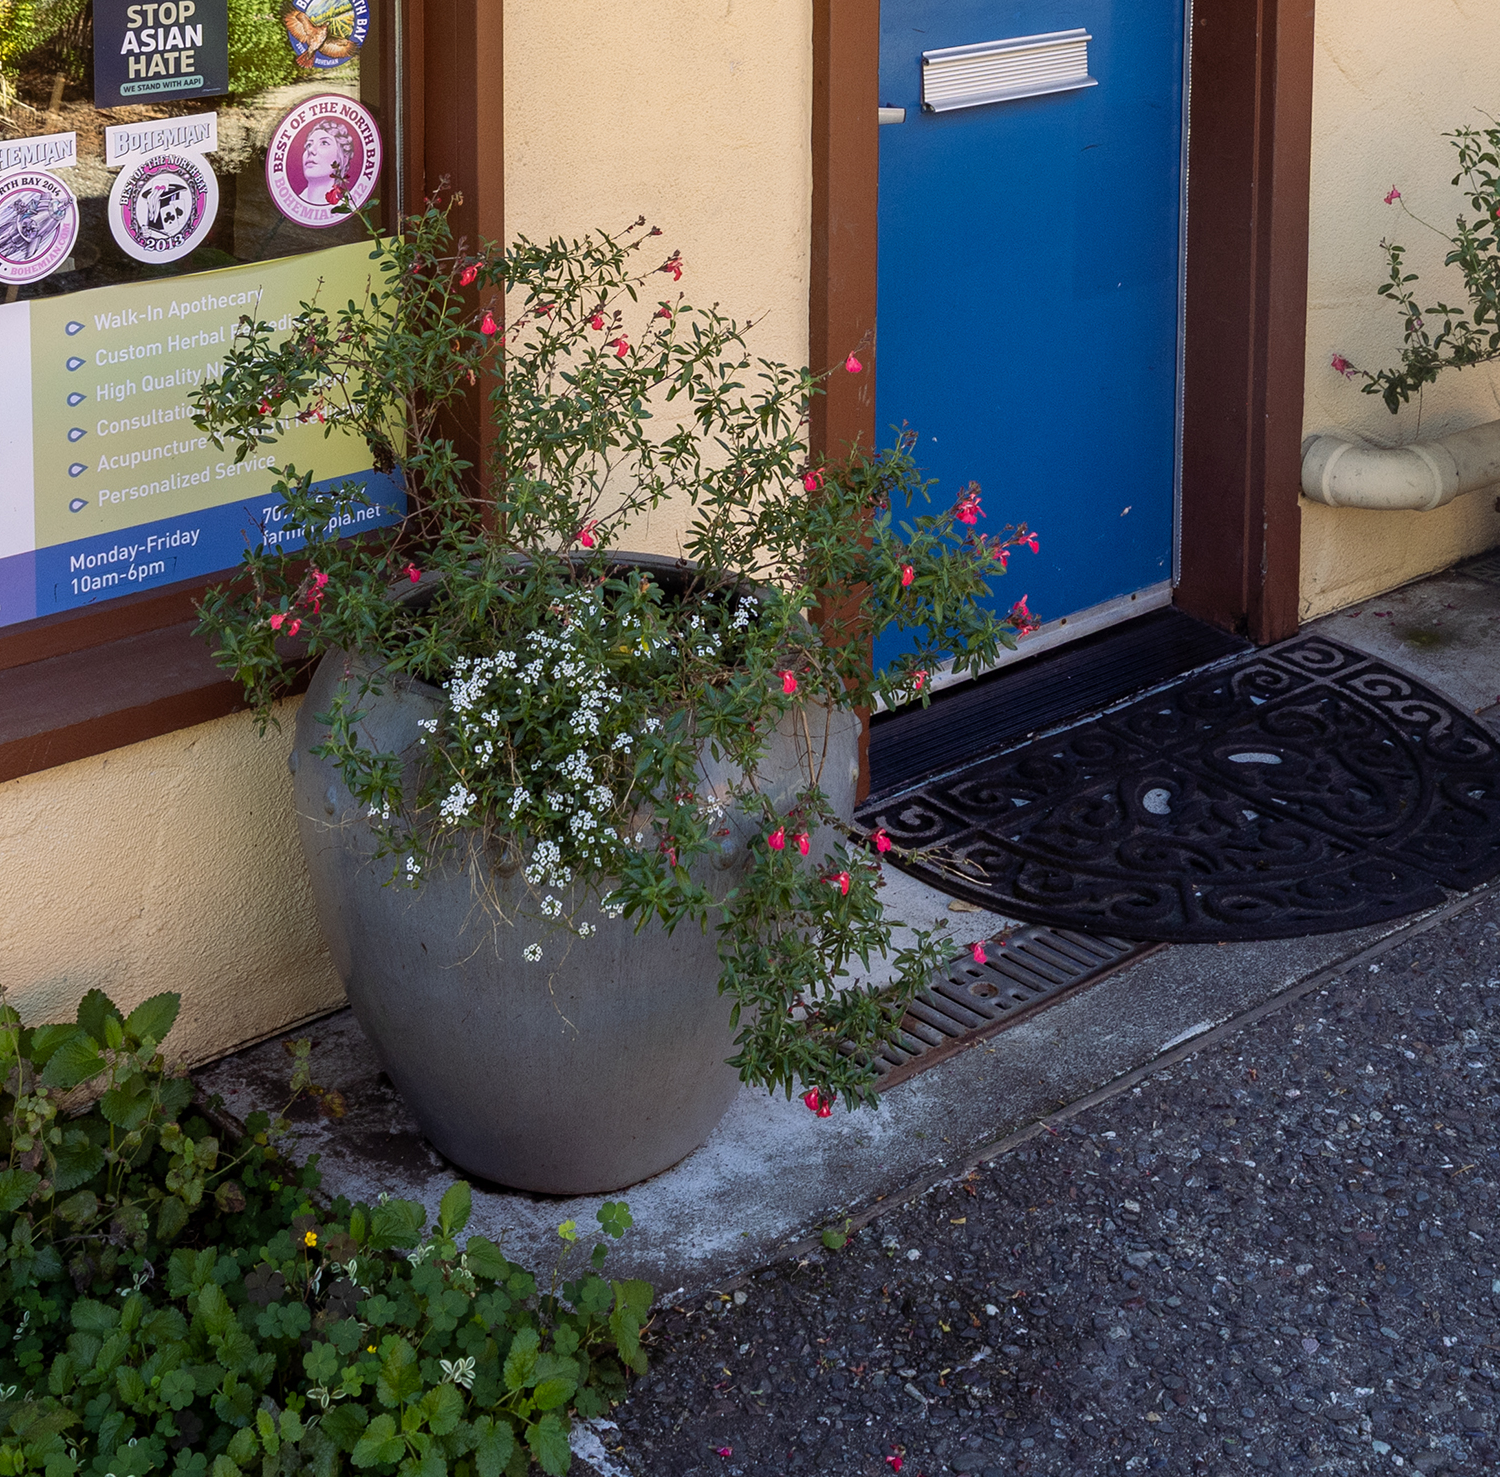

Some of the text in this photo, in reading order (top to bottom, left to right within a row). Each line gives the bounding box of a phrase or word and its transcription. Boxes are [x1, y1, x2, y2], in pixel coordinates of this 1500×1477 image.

[127, 0, 195, 28] STOP
[354, 18, 368, 43] BAY
[120, 24, 203, 54] ASIAN
[129, 50, 195, 79] HATE
[123, 78, 201, 93] WE STAND WITH AAPI
[113, 123, 210, 158] BOHEMIAN
[274, 102, 376, 181] BEST OF THE NORTH BAY
[21, 177, 42, 186] BAY
[42, 180, 61, 197] 2014
[119, 154, 208, 206] BEST THE NORTH BAY
[10, 223, 70, 276] BOHEMIAN.COM
[144, 233, 185, 252] 2013
[94, 288, 263, 331] Walk-In Apothecary
[95, 342, 162, 367] Custom
[167, 326, 226, 352] Herbal
[96, 378, 136, 402] High
[142, 367, 202, 393] Quality
[97, 437, 207, 473] Acupuncture
[98, 453, 276, 507] Personalized Service
[263, 503, 381, 546] farmapia.net
[70, 529, 200, 573] Monday-Friday
[71, 559, 165, 595] 10am-6pm
